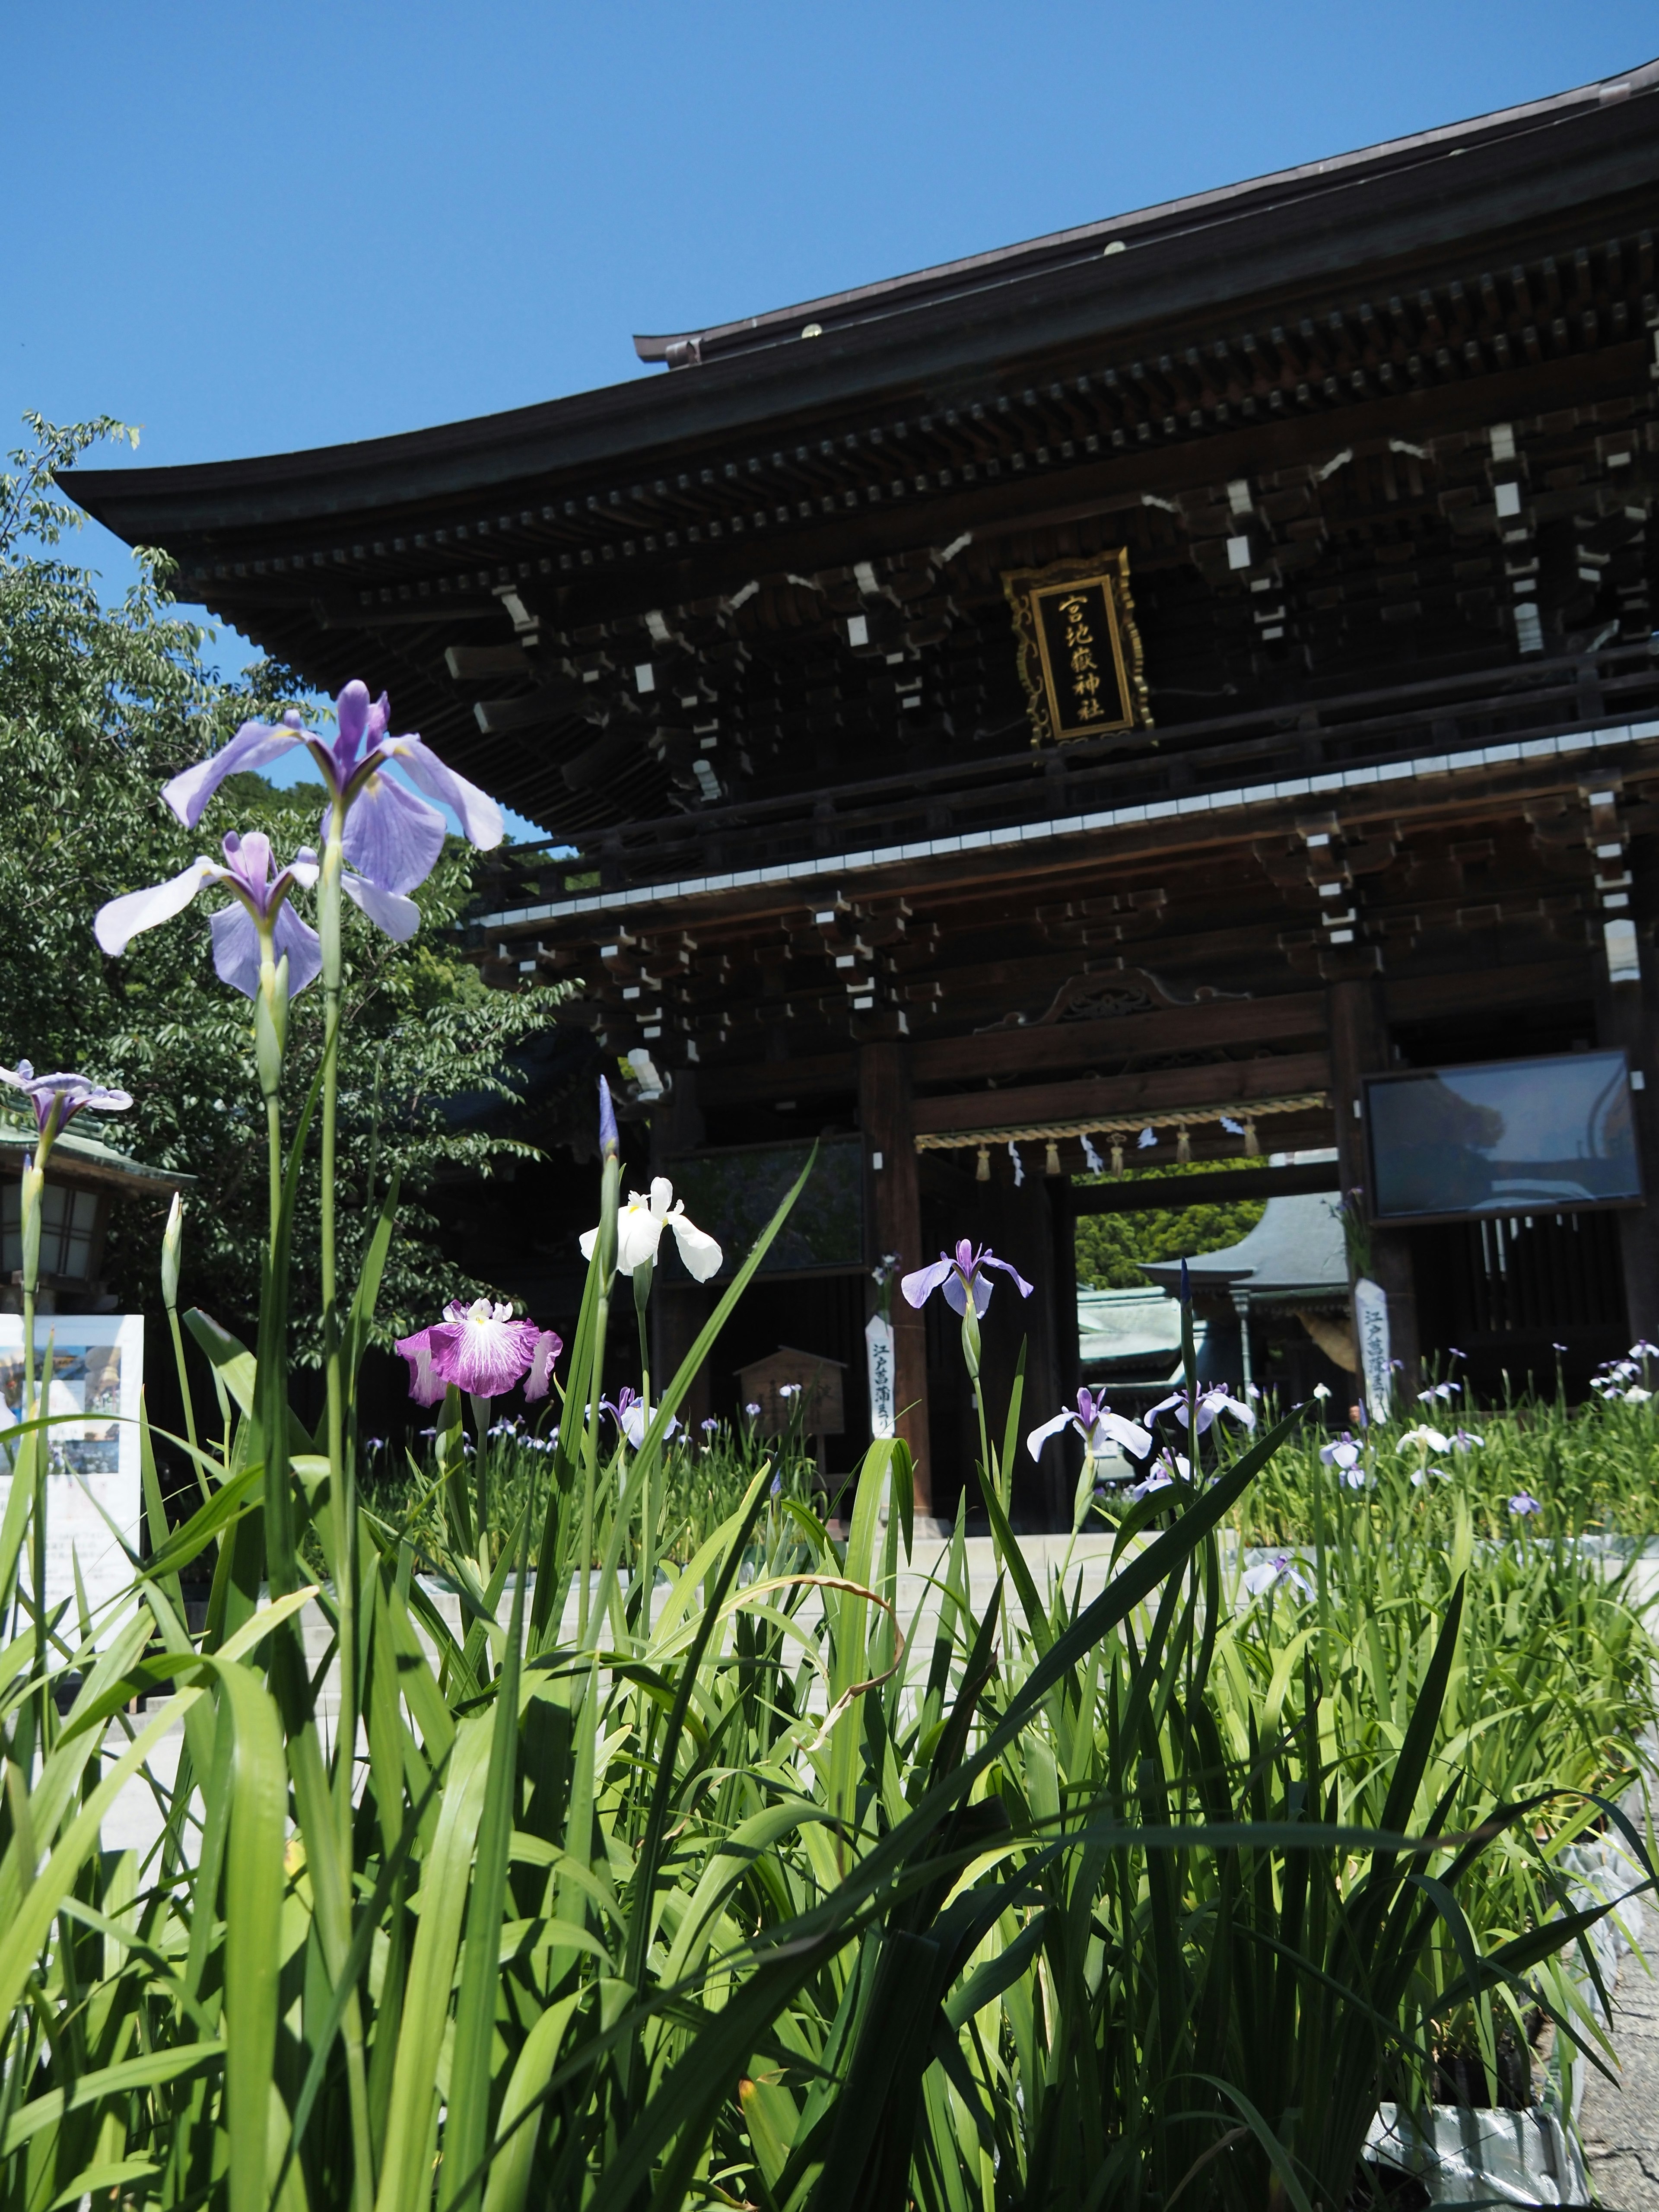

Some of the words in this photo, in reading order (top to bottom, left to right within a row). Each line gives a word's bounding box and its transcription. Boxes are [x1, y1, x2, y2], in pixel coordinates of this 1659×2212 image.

[1058, 594, 1105, 721] 宮地嶽神社
[873, 1343, 890, 1427] 江戸菖蒲まつり
